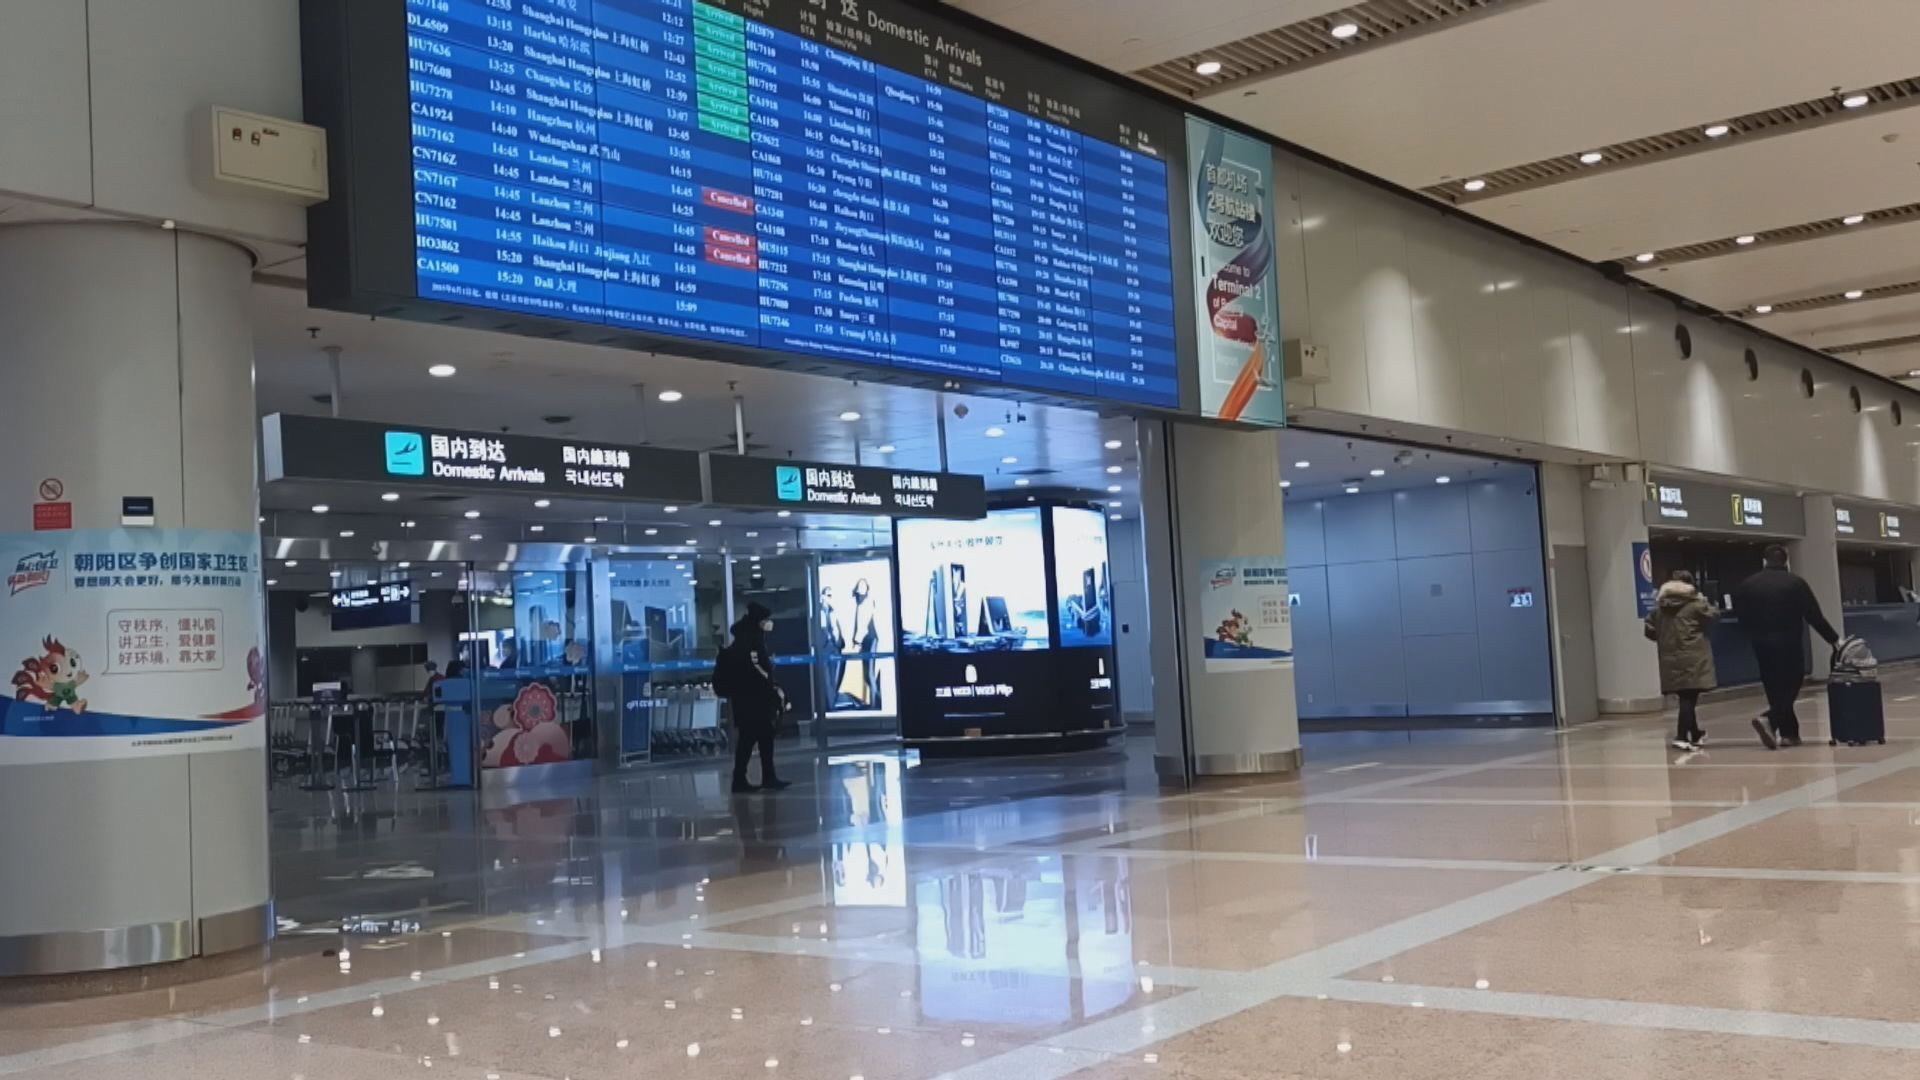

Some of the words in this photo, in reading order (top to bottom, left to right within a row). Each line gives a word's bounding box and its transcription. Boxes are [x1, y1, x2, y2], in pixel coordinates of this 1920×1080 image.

[487, 15, 513, 32] 13:15
[522, 3, 565, 27] Shanghai
[406, 11, 449, 34] DL6509
[487, 35, 514, 53] 13:20
[523, 45, 567, 67] Shanghai
[407, 33, 451, 57] HU7636
[488, 58, 515, 75] 13:25
[867, 10, 930, 48] Domestic
[935, 35, 983, 67] Arrivals
[409, 80, 453, 100] HU7278
[491, 100, 517, 116] 14:10
[489, 79, 516, 96] 13:45
[526, 87, 569, 109] Shanghai
[410, 101, 454, 122] CA1924
[491, 121, 518, 137] 14:40
[670, 165, 692, 179] 14:15
[411, 121, 455, 144] HU7162
[492, 142, 519, 158] 14:45
[671, 183, 694, 197] 14:45
[710, 191, 748, 209] Cancelled
[412, 145, 458, 166] CN716Z
[493, 163, 520, 179] 14:45
[1206, 163, 1248, 194] 首都机场
[413, 168, 458, 188] CN716T
[494, 185, 521, 201] 14:45
[673, 223, 695, 237] 14:45
[712, 229, 750, 246] Cancelled
[414, 190, 457, 210] CN7162
[495, 206, 522, 222] 14:45
[673, 242, 696, 256] 14:45
[713, 248, 751, 265] Cancelled
[415, 211, 457, 232] HU7581
[496, 228, 522, 243] 14:55
[416, 233, 460, 254] HO3862
[496, 249, 523, 264] 15:20
[533, 254, 576, 272] Shanghai
[416, 257, 460, 274] CA1500
[497, 270, 524, 285] 15:20
[534, 275, 554, 289] Dali
[1212, 273, 1254, 298] Terminal
[1255, 285, 1262, 300] 2
[430, 434, 507, 463] 国内到达
[432, 461, 496, 481] Domestic
[499, 465, 546, 484] Arrivals
[564, 468, 625, 489] 국내선도착
[805, 467, 856, 490] 国内到达
[806, 488, 849, 504] Domestic
[850, 491, 882, 506] Arrivals
[74, 552, 250, 573] 朝阳区争创国家卫生区
